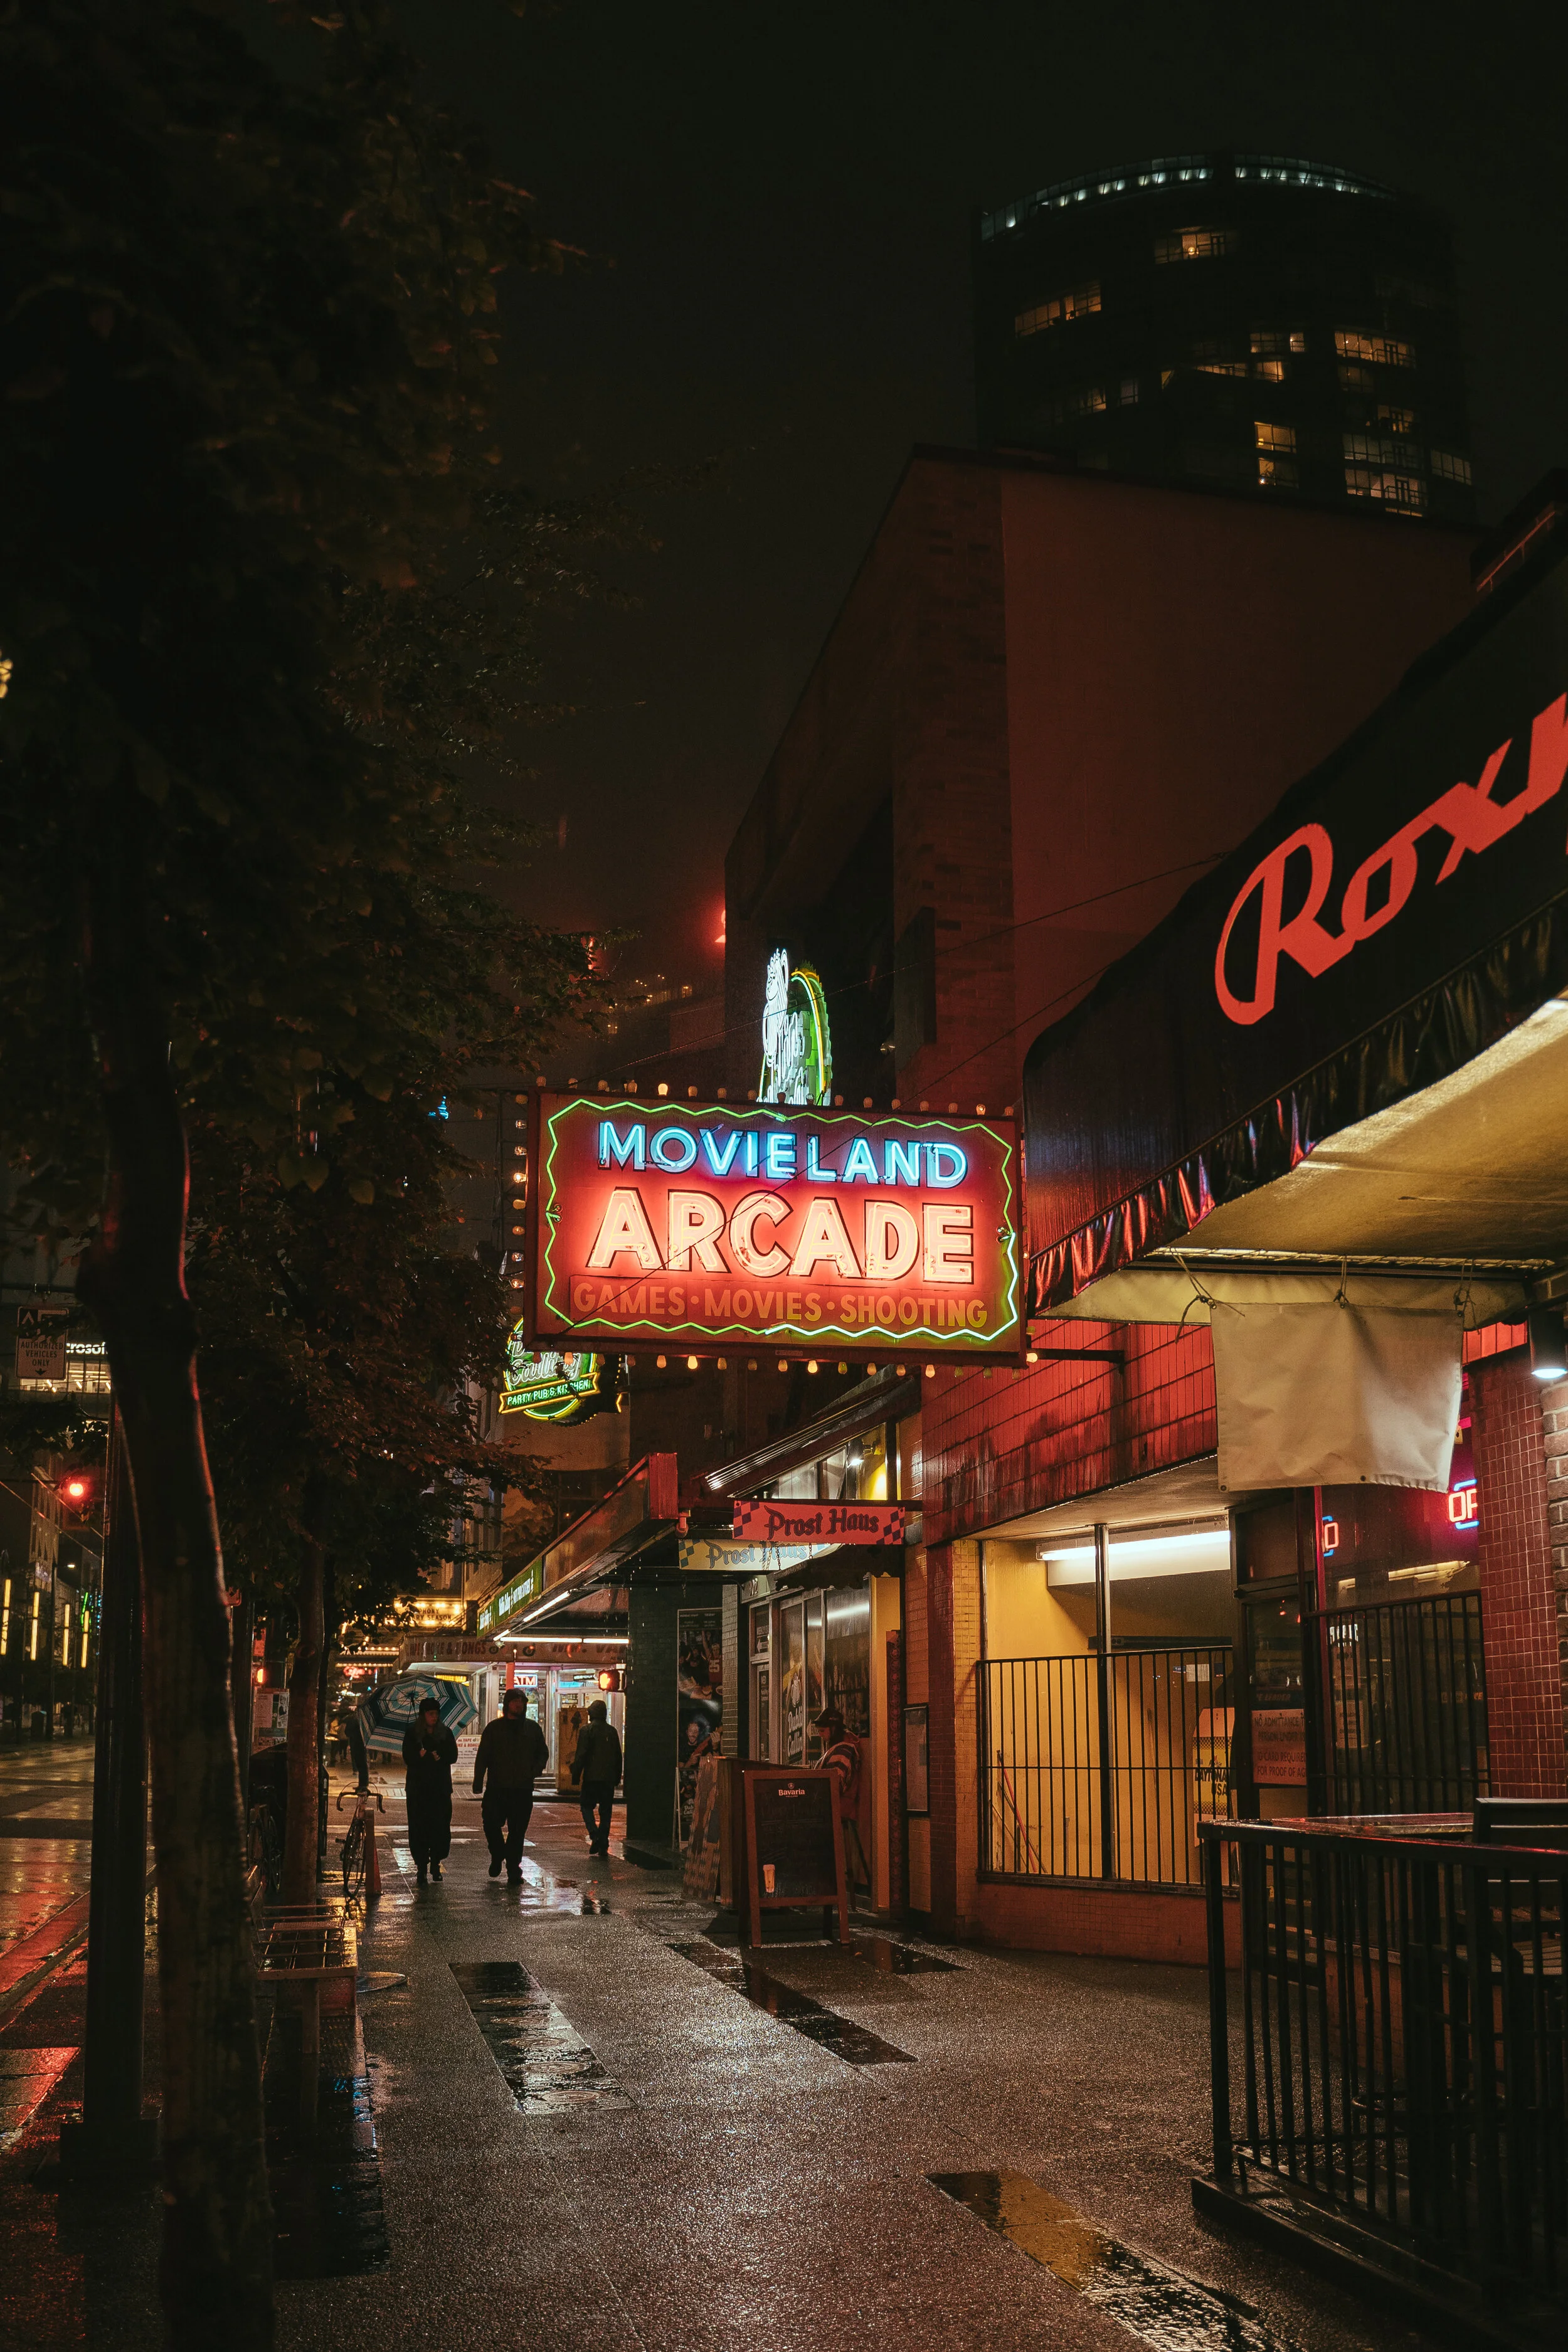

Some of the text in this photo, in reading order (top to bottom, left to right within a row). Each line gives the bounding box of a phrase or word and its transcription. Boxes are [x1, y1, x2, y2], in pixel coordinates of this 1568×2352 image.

[585, 1186, 973, 1284] ARCADE
[573, 1282, 988, 1328] GAMES MOVIES SHOOTING
[21, 1341, 63, 1350] AUTHORIZED
[26, 1350, 57, 1358] VEHICLES
[66, 1342, 108, 1355] crosof
[507, 1379, 588, 1405] PARTY PUB & KIHEN
[1448, 1488, 1478, 1522] OP
[764, 1505, 879, 1540] Prost Haus
[704, 1540, 807, 1569] Prost Haus
[514, 1676, 536, 1685] ATM
[788, 1705, 803, 1733] Dubli
[787, 1731, 803, 1757] Callin
[1264, 1751, 1278, 1761] CARD
[1194, 1767, 1227, 1782] DAYTNA
[1257, 1766, 1306, 1777] FOR PROOF OF AG
[778, 1788, 805, 1796] Bavaria
